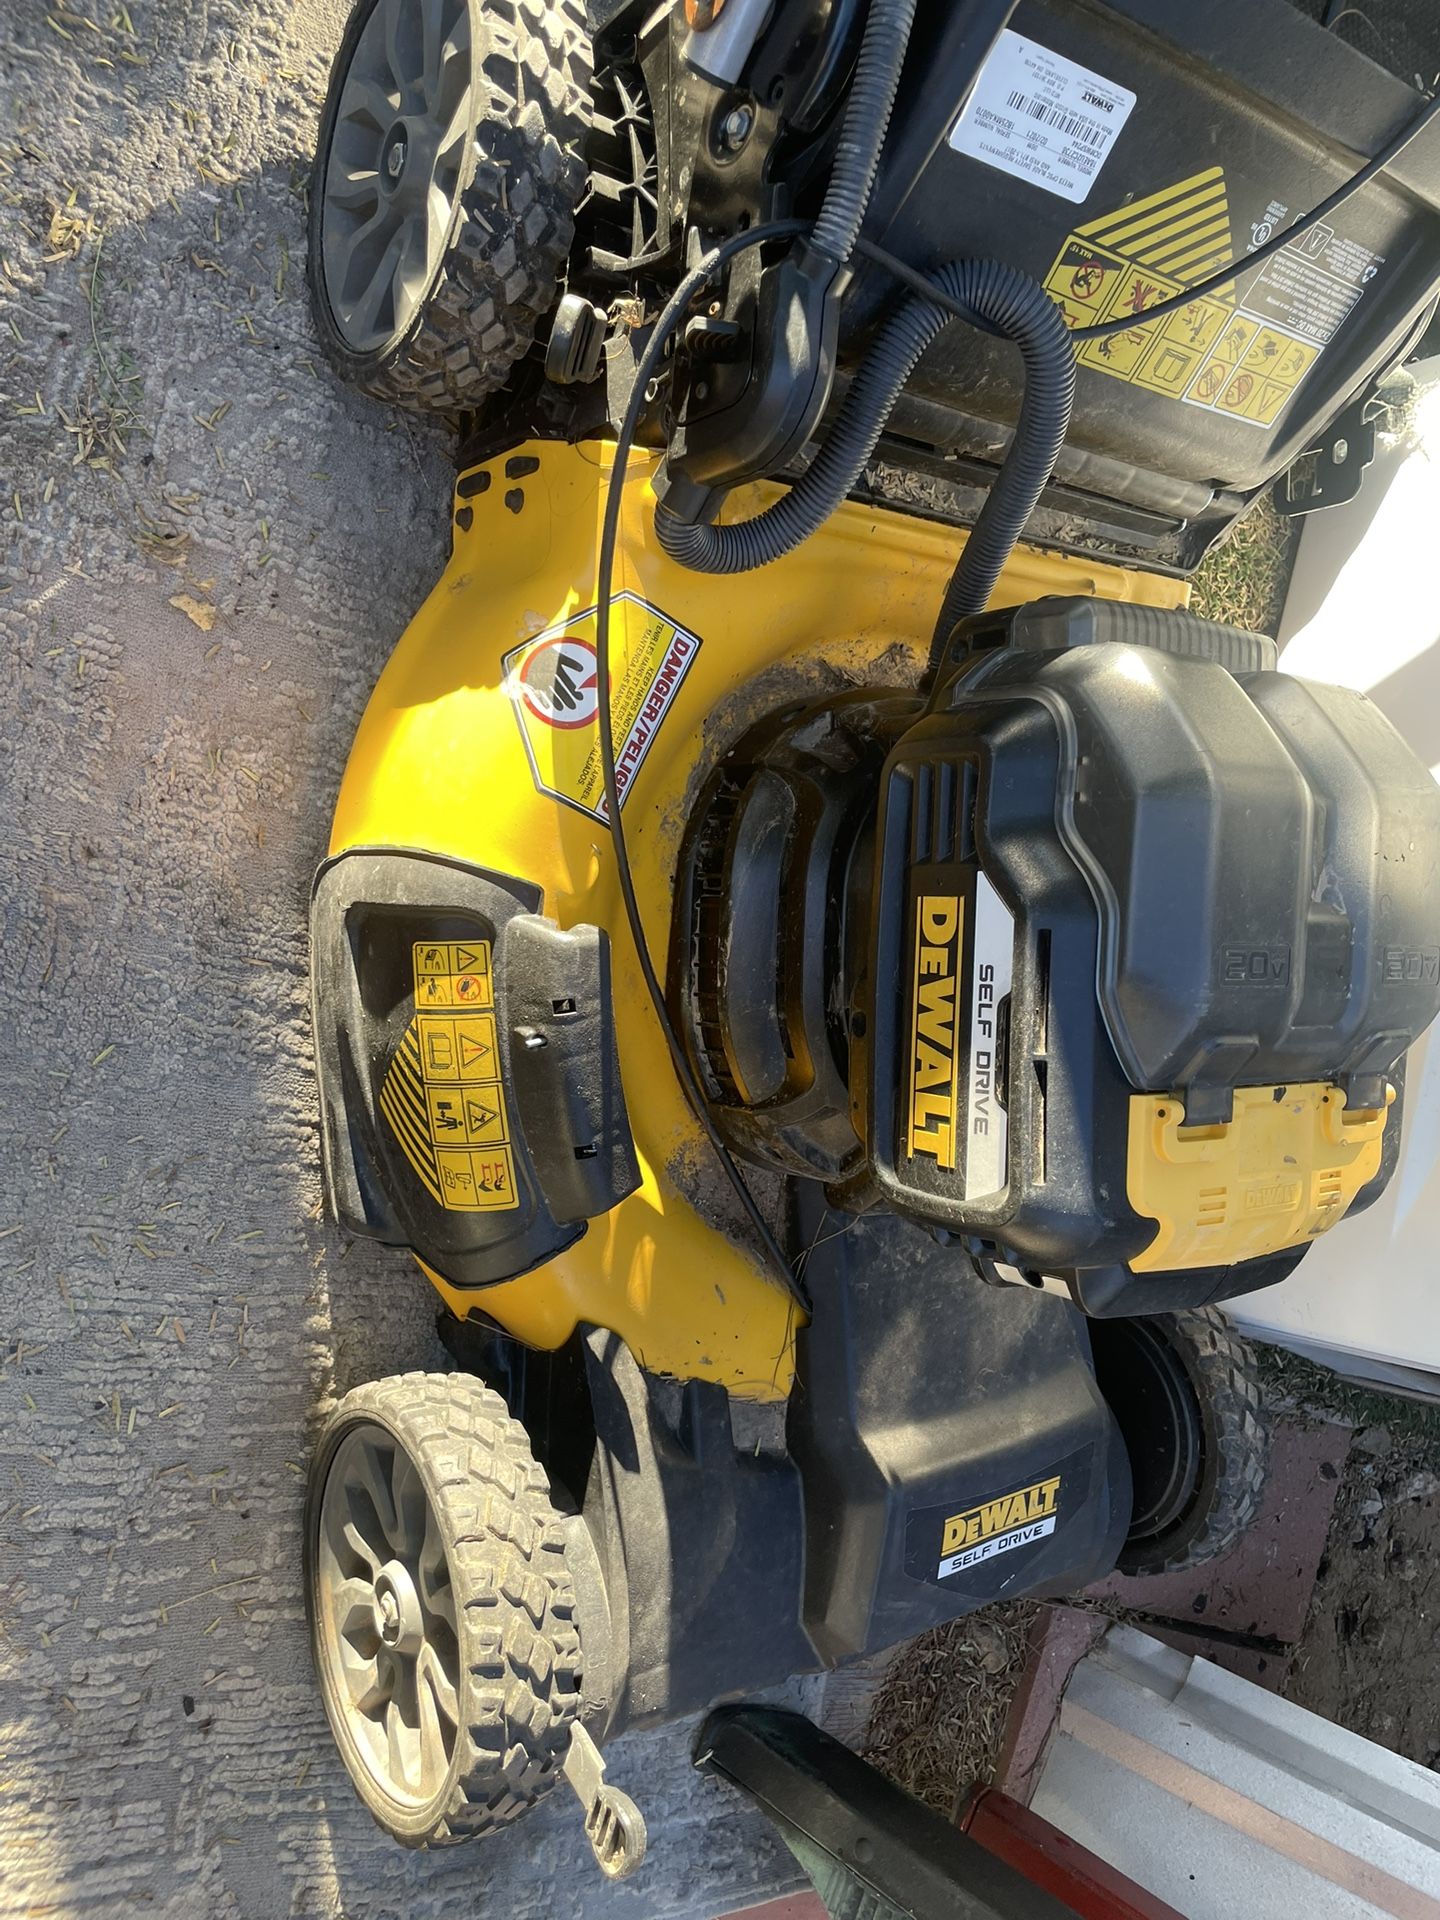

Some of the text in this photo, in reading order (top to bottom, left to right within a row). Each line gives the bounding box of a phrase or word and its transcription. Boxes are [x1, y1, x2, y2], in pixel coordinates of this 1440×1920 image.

[1077, 113, 1089, 123] USA
[1088, 118, 1096, 126] the
[972, 117, 1011, 139] SERIAL NUMBER
[1100, 124, 1113, 135] Made
[1025, 129, 1049, 145] 02/2021
[978, 141, 1074, 189] MEETS CPSC BLADE SAFETY REQUIREMENTS
[1039, 161, 1051, 170] AND
[1057, 155, 1093, 175] MODEL NUMBER
[1264, 213, 1279, 225] LISTED
[1079, 248, 1093, 259] MAX
[1294, 319, 1307, 330] DC
[1303, 323, 1318, 335] MAX
[651, 621, 664, 642] TENIR
[629, 627, 651, 668] MANTENGA
[645, 641, 655, 656] LES
[635, 654, 649, 678] MAINS
[622, 667, 633, 683] LAS
[631, 676, 639, 687] ET
[641, 666, 654, 687] KEEP
[610, 682, 626, 710] MANOS
[625, 686, 635, 700] LES
[629, 685, 645, 712] HANDS
[615, 699, 629, 721] PIEDS
[622, 710, 634, 727] AND
[614, 727, 626, 746] FEET
[974, 964, 994, 1136] SELF DRIVE
[951, 1524, 1044, 1570] SELF DRIVE
